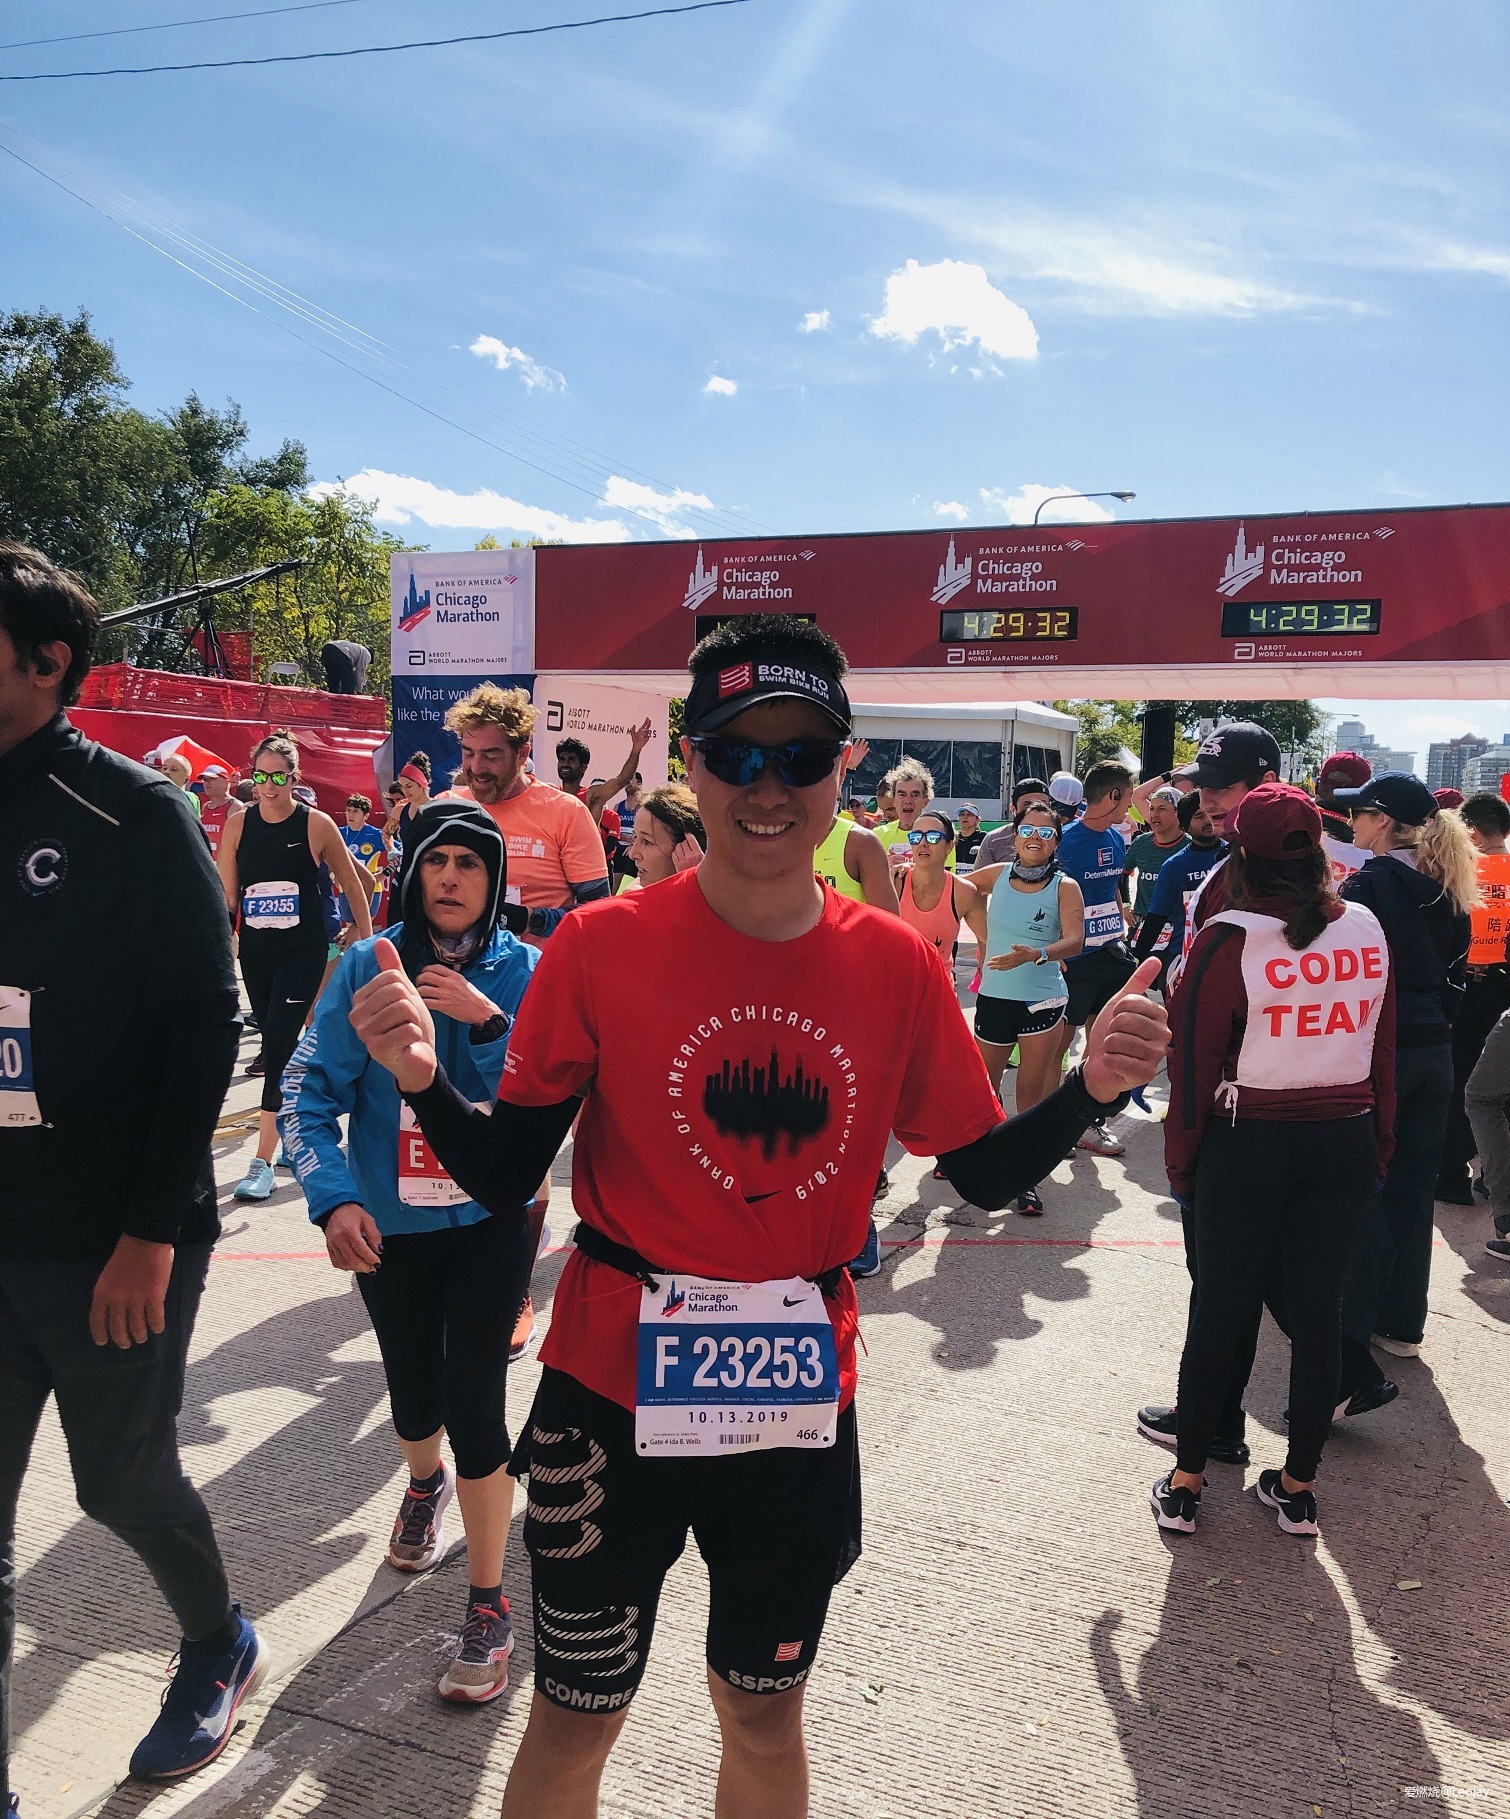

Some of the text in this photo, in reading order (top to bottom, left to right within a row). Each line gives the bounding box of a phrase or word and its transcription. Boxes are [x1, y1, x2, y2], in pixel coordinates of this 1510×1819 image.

[1272, 532, 1371, 543] BANK OF AMERICA
[979, 547, 1004, 555] BANK
[1020, 544, 1064, 553] AMERICA
[723, 556, 746, 564] BANK
[760, 554, 797, 562] AMERICA
[1271, 548, 1346, 568] Chicago
[978, 560, 1043, 578] Chicago
[468, 578, 503, 586] AMERICA
[723, 568, 780, 585] Chicago
[1270, 568, 1362, 585] Marathon
[977, 577, 1057, 593] Marathon
[722, 585, 793, 600] Marathon
[435, 592, 488, 609] Chicago
[436, 609, 500, 623] Marathon
[758, 665, 829, 692] BORN TO
[412, 686, 445, 700] What
[759, 675, 829, 700] SWIM BIKE RUN
[397, 708, 417, 721] like
[420, 708, 440, 721] the
[588, 723, 625, 735] MARATHON
[507, 843, 529, 851] BIKE
[509, 836, 532, 844] SWIM
[247, 898, 294, 914] F 23155
[1089, 917, 1121, 934] G 37085
[1472, 936, 1499, 945] Guide
[1264, 946, 1383, 990] CODE
[667, 1005, 858, 1201] BANK OF AMERICA CHICAGO MARATHON 2019
[8, 1113, 26, 1122] 477
[409, 1138, 425, 1169] E
[688, 1292, 729, 1303] Chicago
[688, 1303, 738, 1312] Marathon
[655, 1335, 825, 1389] F 23253
[688, 1411, 789, 1424] 10.13.2019
[796, 1429, 819, 1440] 466
[544, 1677, 634, 1710] COMPRE
